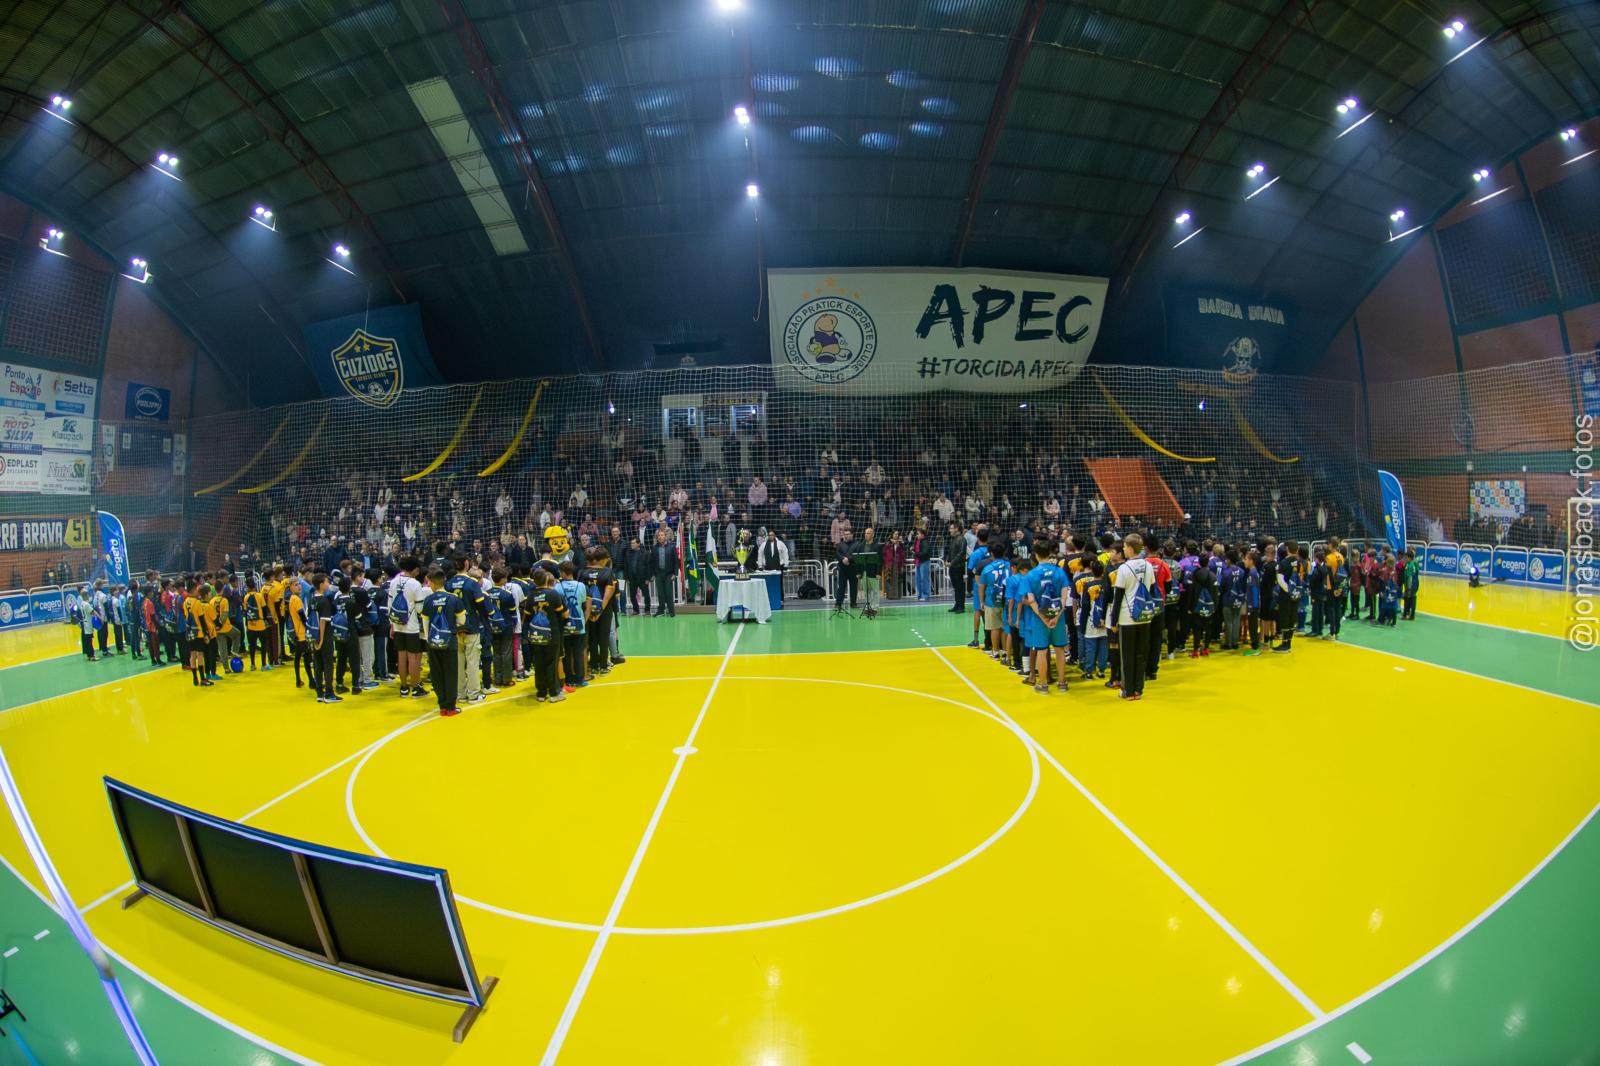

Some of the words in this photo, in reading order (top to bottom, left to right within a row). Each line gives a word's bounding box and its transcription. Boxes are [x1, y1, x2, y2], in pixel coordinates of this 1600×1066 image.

[803, 300, 843, 317] PRATICK
[916, 284, 1092, 349] APEC
[845, 304, 874, 341] ESPORTE
[339, 351, 397, 379] CUZIDOS
[851, 344, 874, 372] CLUBE
[64, 380, 94, 395] Setta
[815, 373, 845, 381] APEC
[0, 523, 18, 549] RA
[23, 522, 63, 547] BRAVA
[110, 539, 123, 576] cegero
[1502, 560, 1526, 570] cegero
[40, 600, 62, 611] cegero
